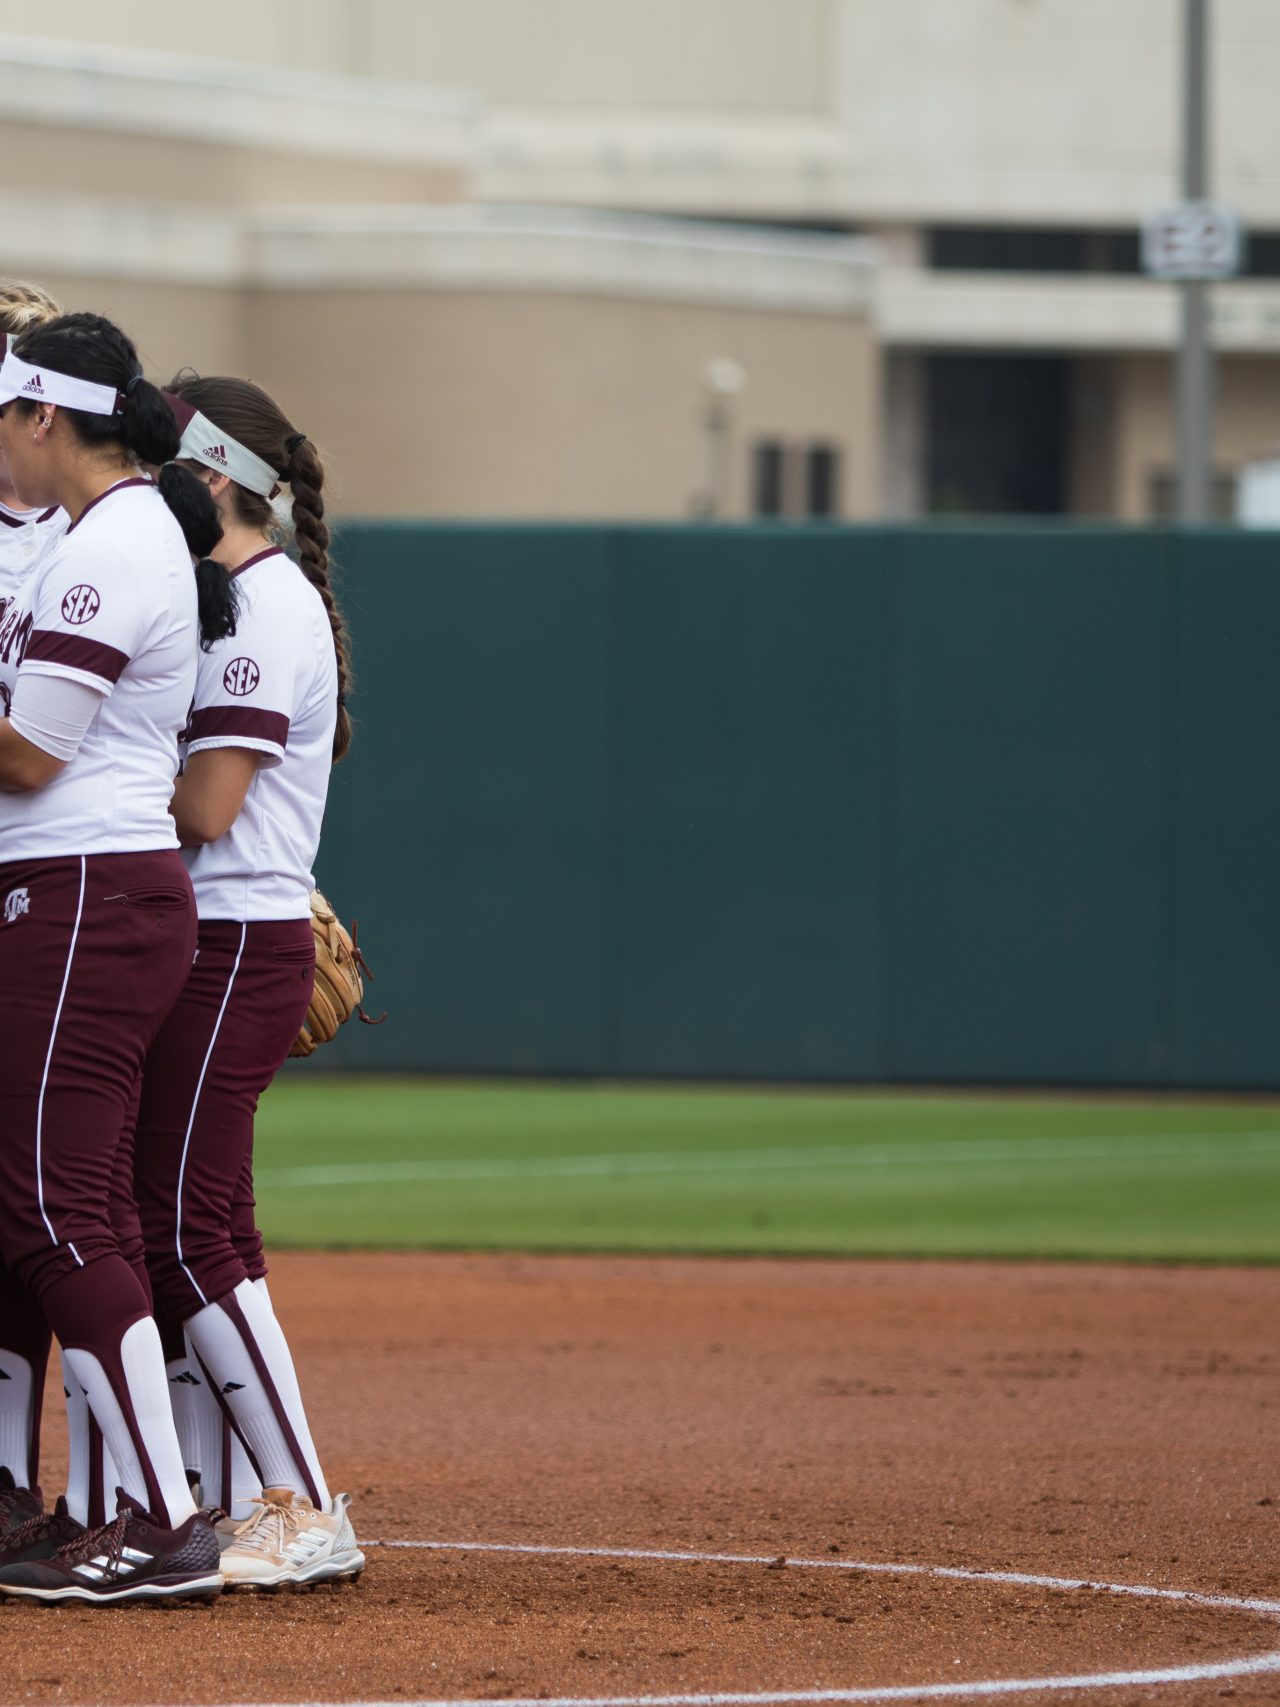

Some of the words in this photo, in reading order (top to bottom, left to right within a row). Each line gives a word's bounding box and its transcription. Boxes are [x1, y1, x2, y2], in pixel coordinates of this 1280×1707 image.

[22, 384, 45, 395] adidas
[202, 448, 229, 467] adidas
[62, 584, 101, 625] SEC
[223, 657, 260, 697] SEC
